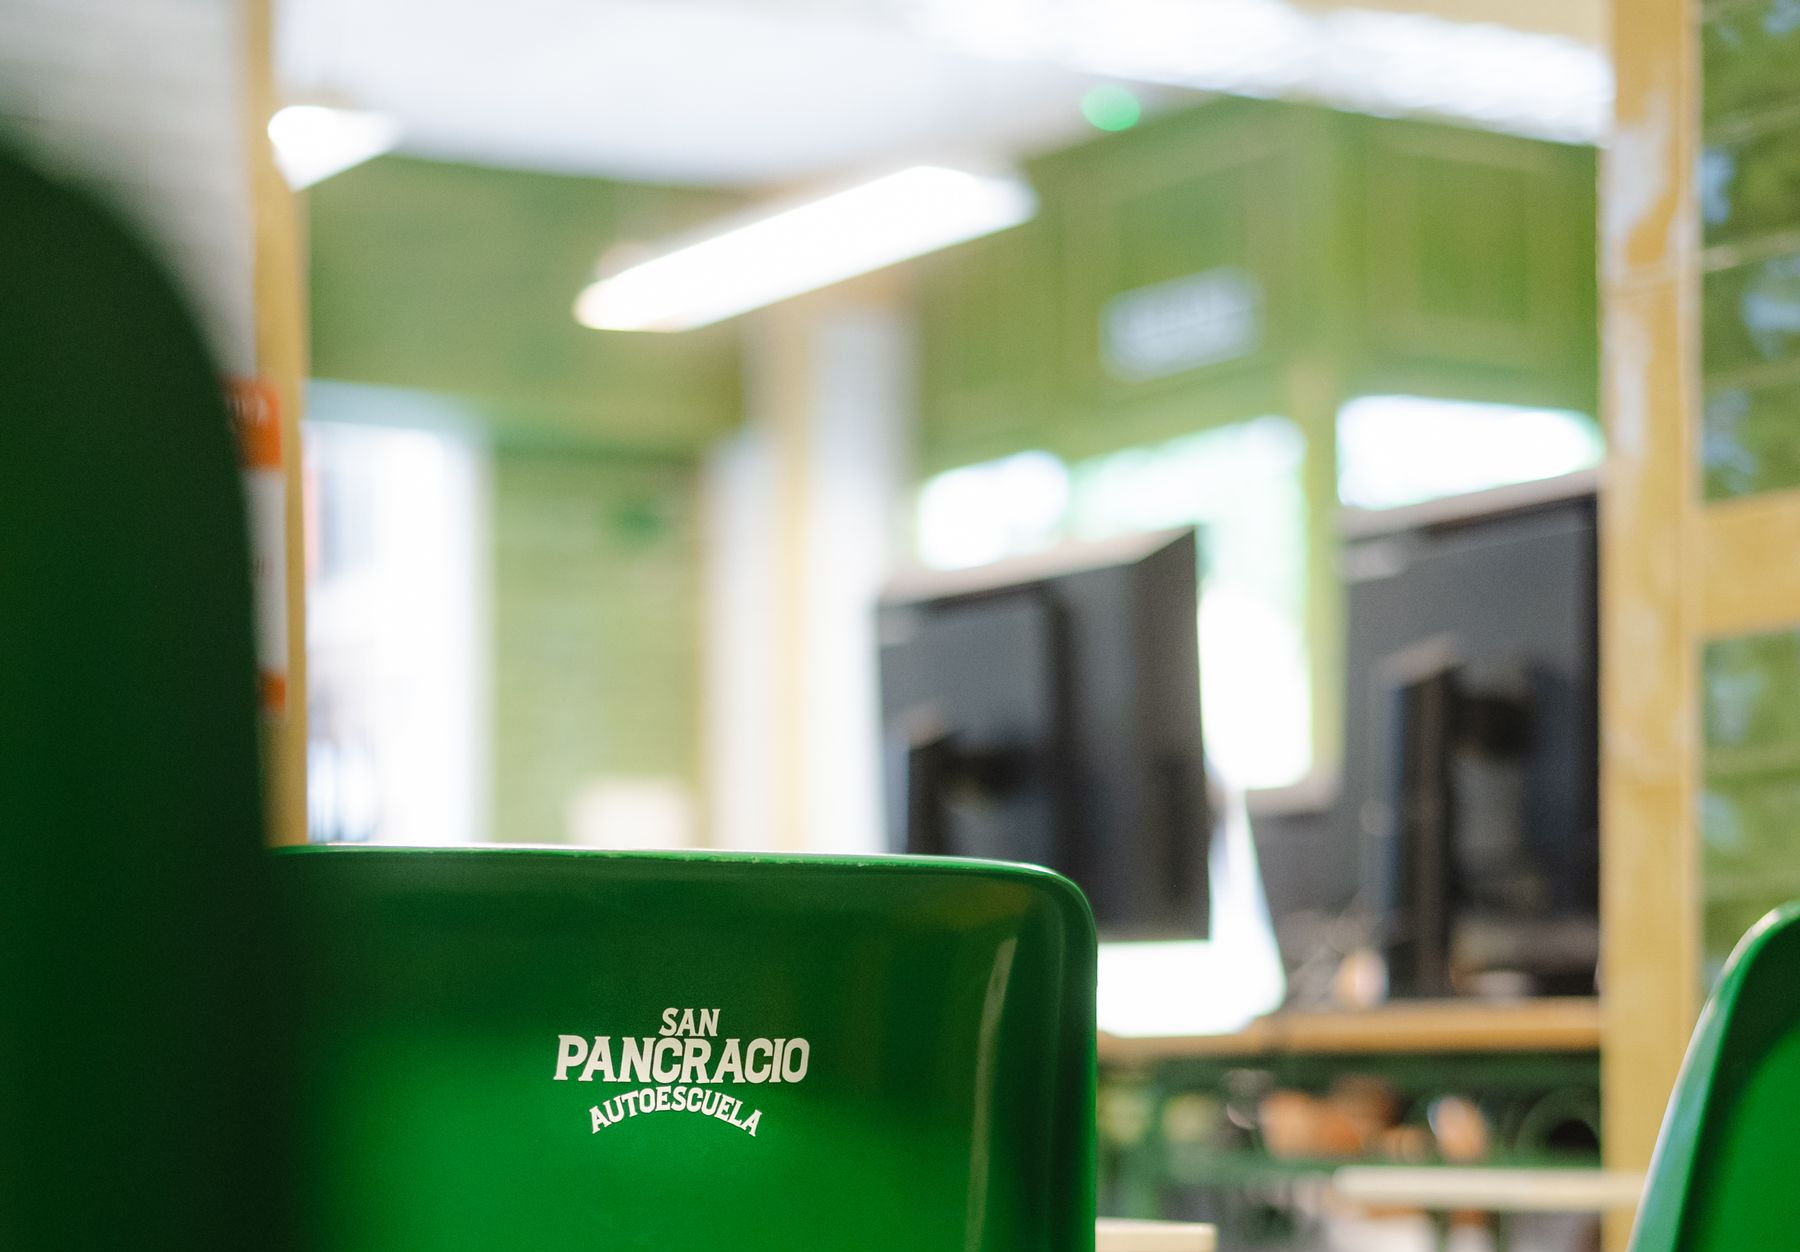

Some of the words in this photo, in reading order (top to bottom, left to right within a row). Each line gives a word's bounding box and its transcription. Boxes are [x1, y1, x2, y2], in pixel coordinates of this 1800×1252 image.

[658, 1007, 720, 1037] SAN
[553, 1034, 810, 1083] PANCRACIO
[588, 1085, 762, 1136] AUTOESCUELA
